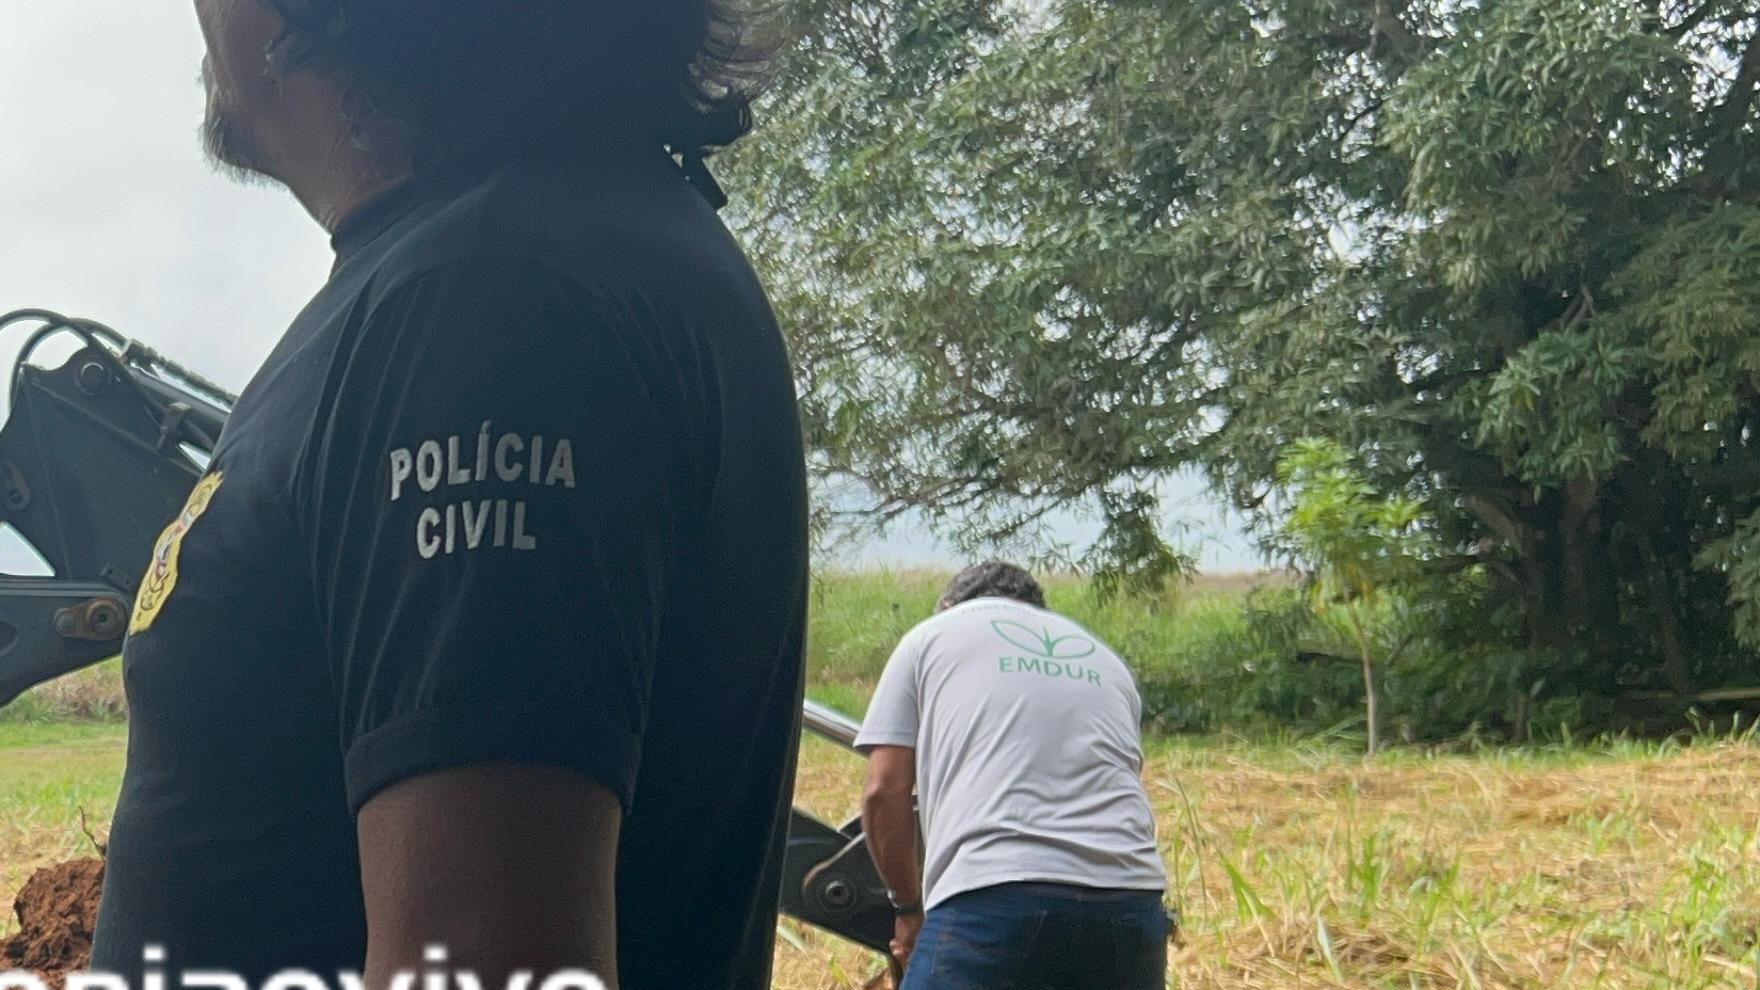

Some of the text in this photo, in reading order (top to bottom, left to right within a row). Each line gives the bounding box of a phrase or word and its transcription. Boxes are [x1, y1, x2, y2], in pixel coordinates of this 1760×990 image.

[390, 420, 576, 501] POLÍCIA
[417, 499, 536, 559] CIVIL
[998, 656, 1101, 687] EMDUR
